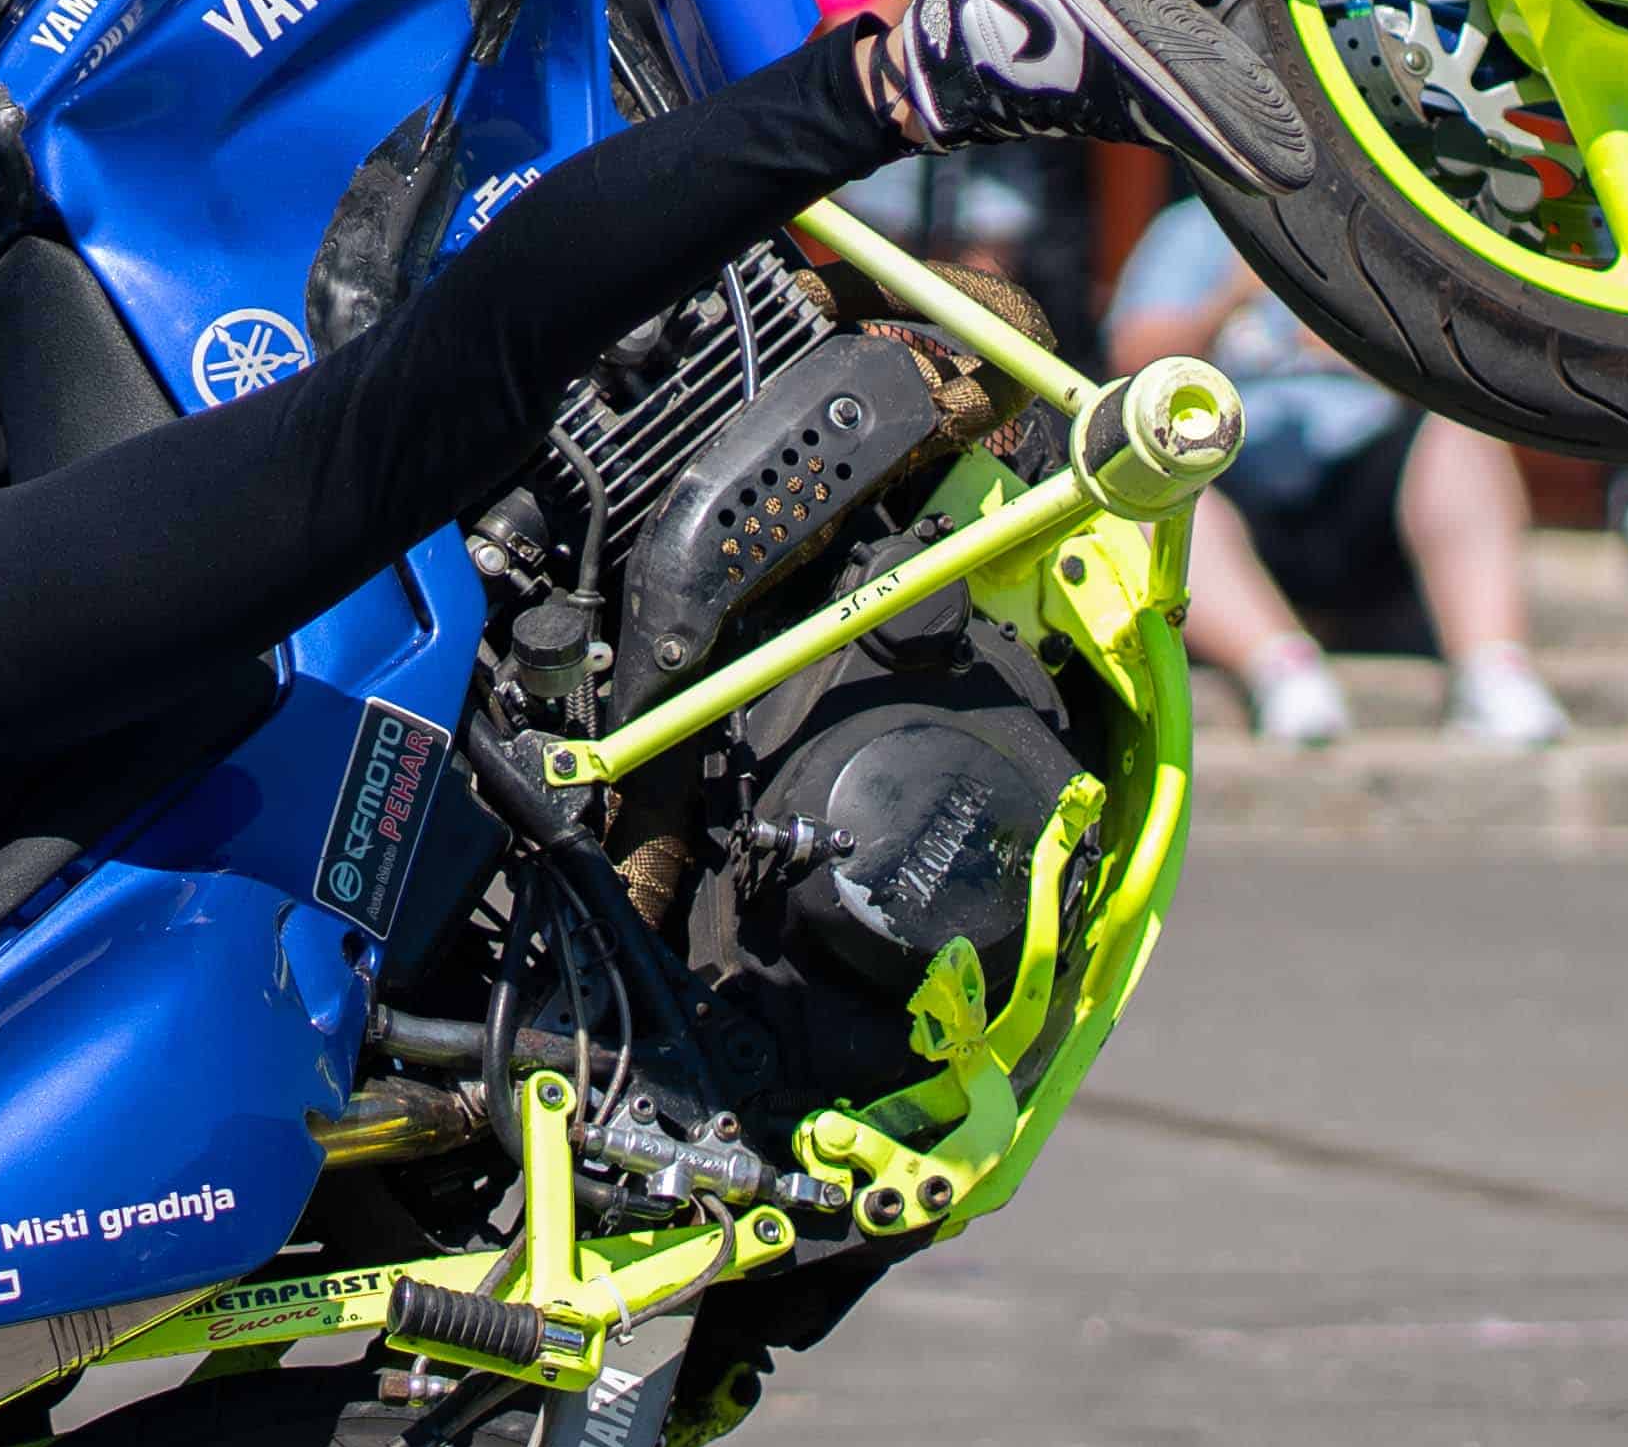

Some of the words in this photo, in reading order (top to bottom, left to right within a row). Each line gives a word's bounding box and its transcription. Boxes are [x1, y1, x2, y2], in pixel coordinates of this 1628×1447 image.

[378, 729, 434, 843] PEHAR
[0, 1208, 89, 1251] Misti
[98, 1183, 236, 1240] gradnja
[207, 1304, 322, 1342] Encore
[322, 1312, 363, 1326] d.o.o.
